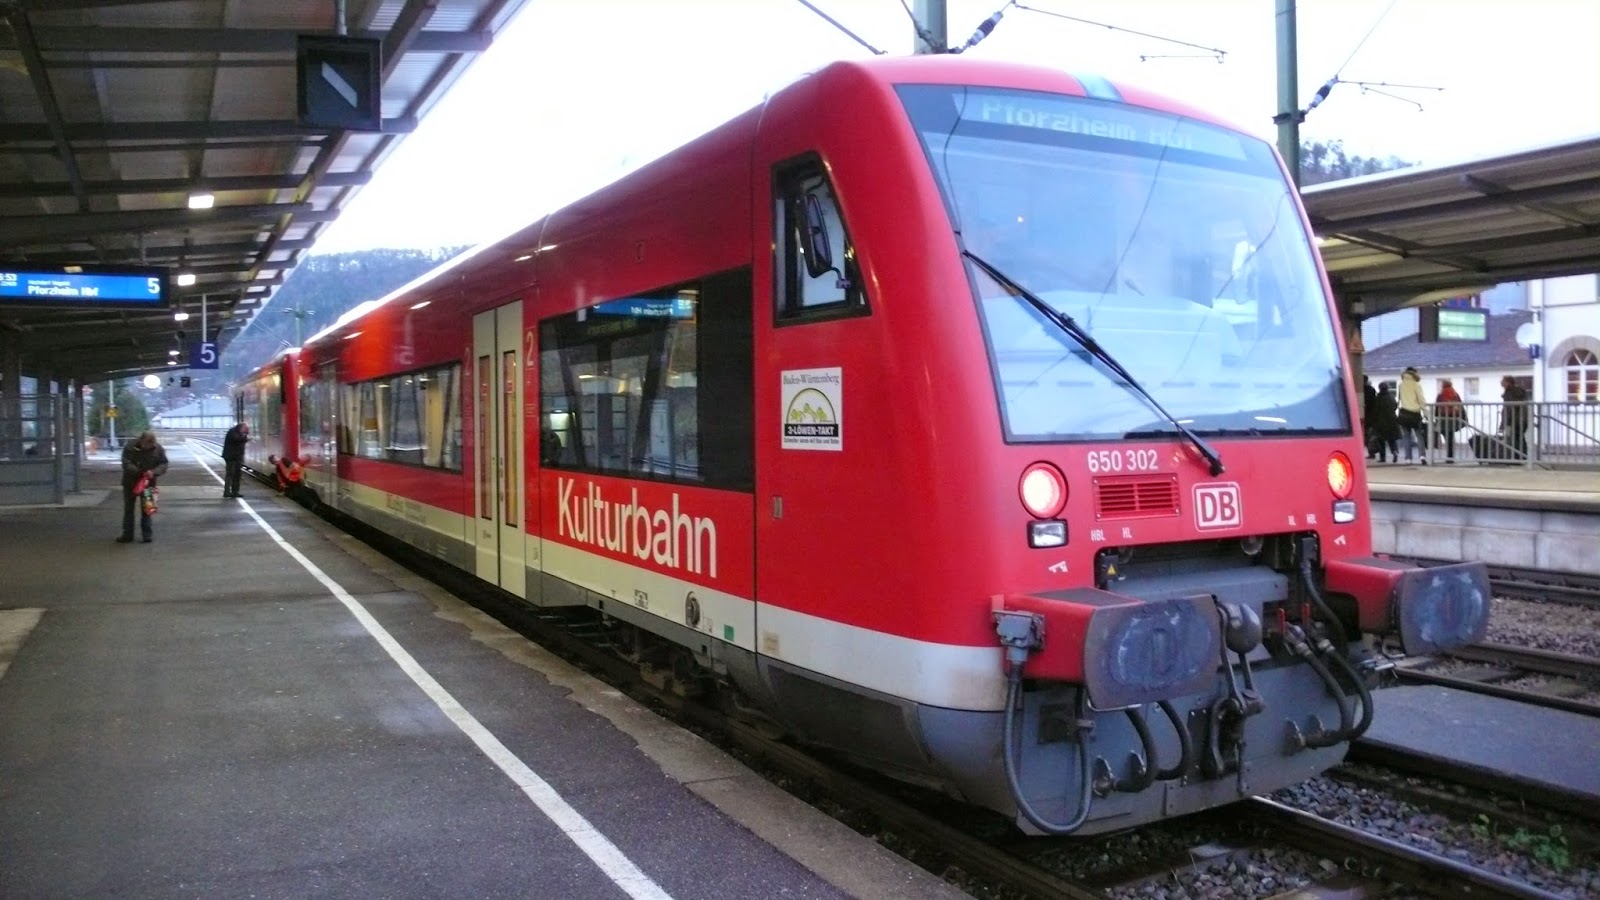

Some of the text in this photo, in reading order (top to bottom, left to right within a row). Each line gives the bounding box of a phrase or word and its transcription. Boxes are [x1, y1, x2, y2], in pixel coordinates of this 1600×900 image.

[147, 277, 160, 294] 5
[200, 343, 215, 364] 5
[526, 331, 534, 366] 2
[1087, 449, 1158, 472] 650 302
[1200, 491, 1236, 523] DB
[558, 477, 717, 578] Kulturbahn
